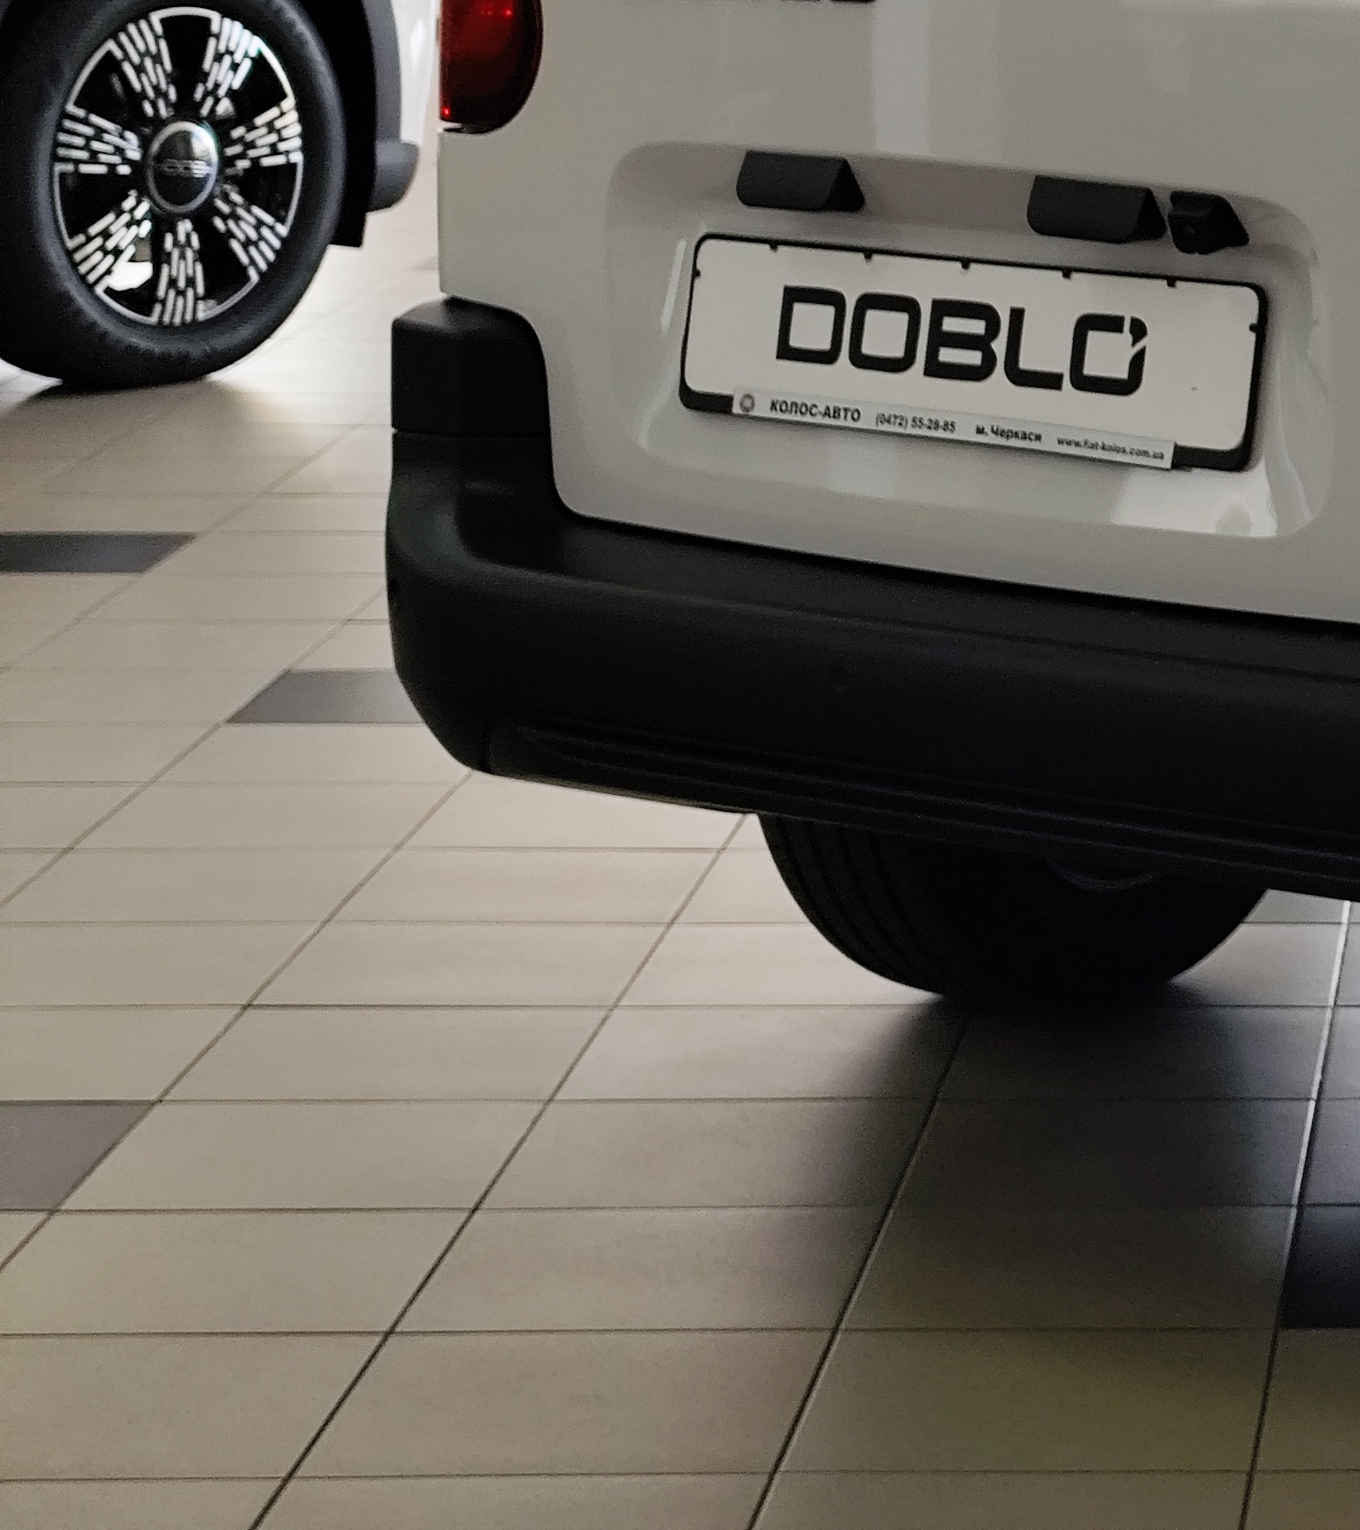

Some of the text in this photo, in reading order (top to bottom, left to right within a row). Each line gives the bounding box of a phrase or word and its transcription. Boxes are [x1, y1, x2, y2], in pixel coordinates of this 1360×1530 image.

[776, 285, 1148, 397] DOBLO
[770, 398, 861, 422] КОЛОС-АВТО
[875, 412, 908, 430] (0472)
[990, 424, 1042, 443] Черкаси
